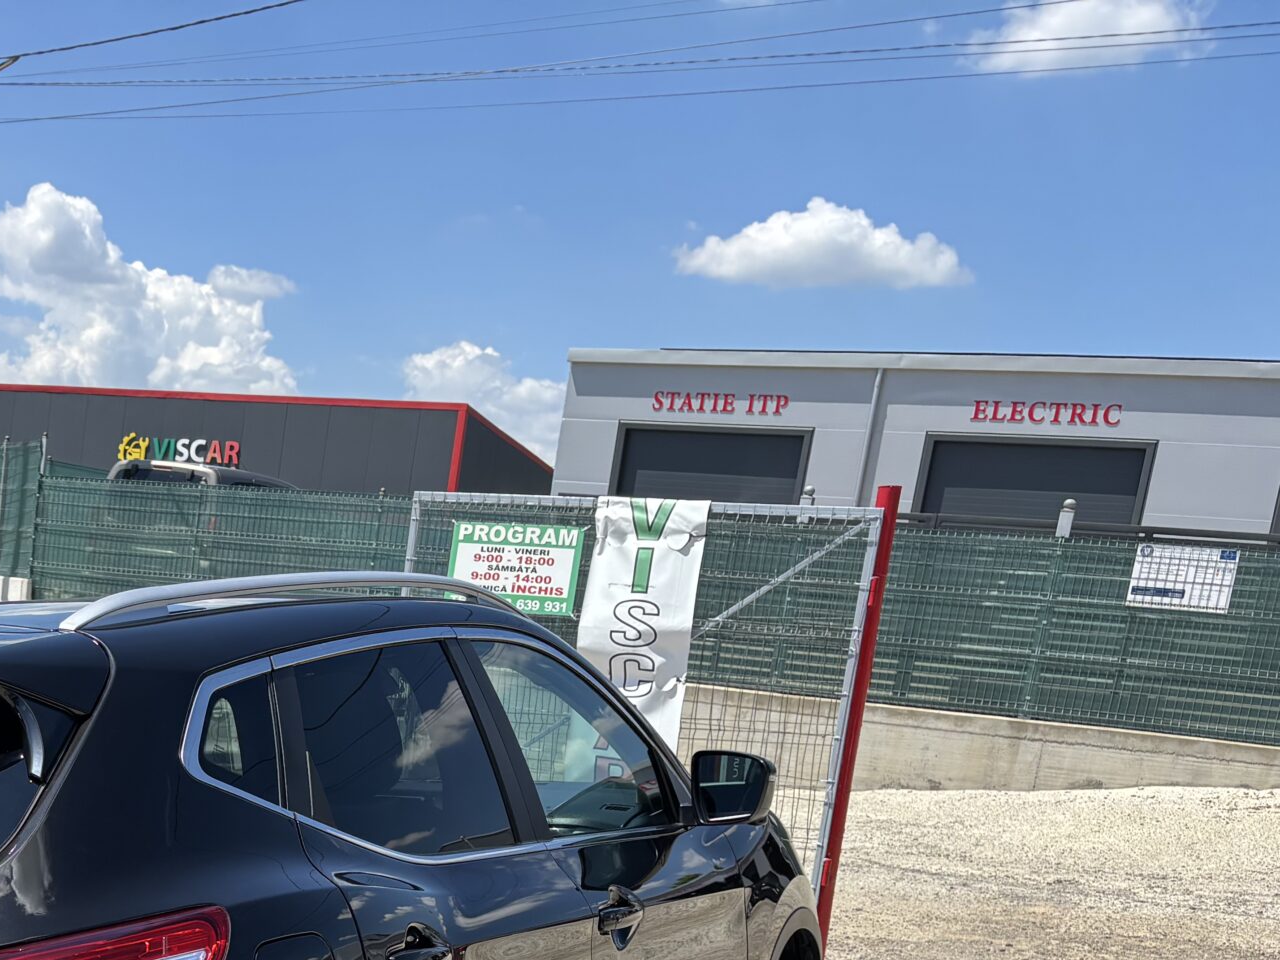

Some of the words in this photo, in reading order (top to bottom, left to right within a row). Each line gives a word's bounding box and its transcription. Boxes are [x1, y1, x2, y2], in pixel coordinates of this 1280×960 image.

[652, 390, 736, 414] STATIE
[745, 393, 790, 416] ITP
[970, 400, 1123, 427] ELECTRIC
[153, 437, 240, 465] VISCAR
[458, 523, 579, 547] PROGRAM
[480, 546, 505, 554] LUNI
[514, 548, 551, 556] VINERI
[473, 553, 503, 563] 9:00
[516, 556, 555, 567] 18:00
[470, 571, 500, 581] 9:00
[513, 574, 552, 584] 14:00
[510, 582, 564, 597] ÎNCHIS
[516, 599, 540, 611] 639
[544, 600, 567, 612] 931
